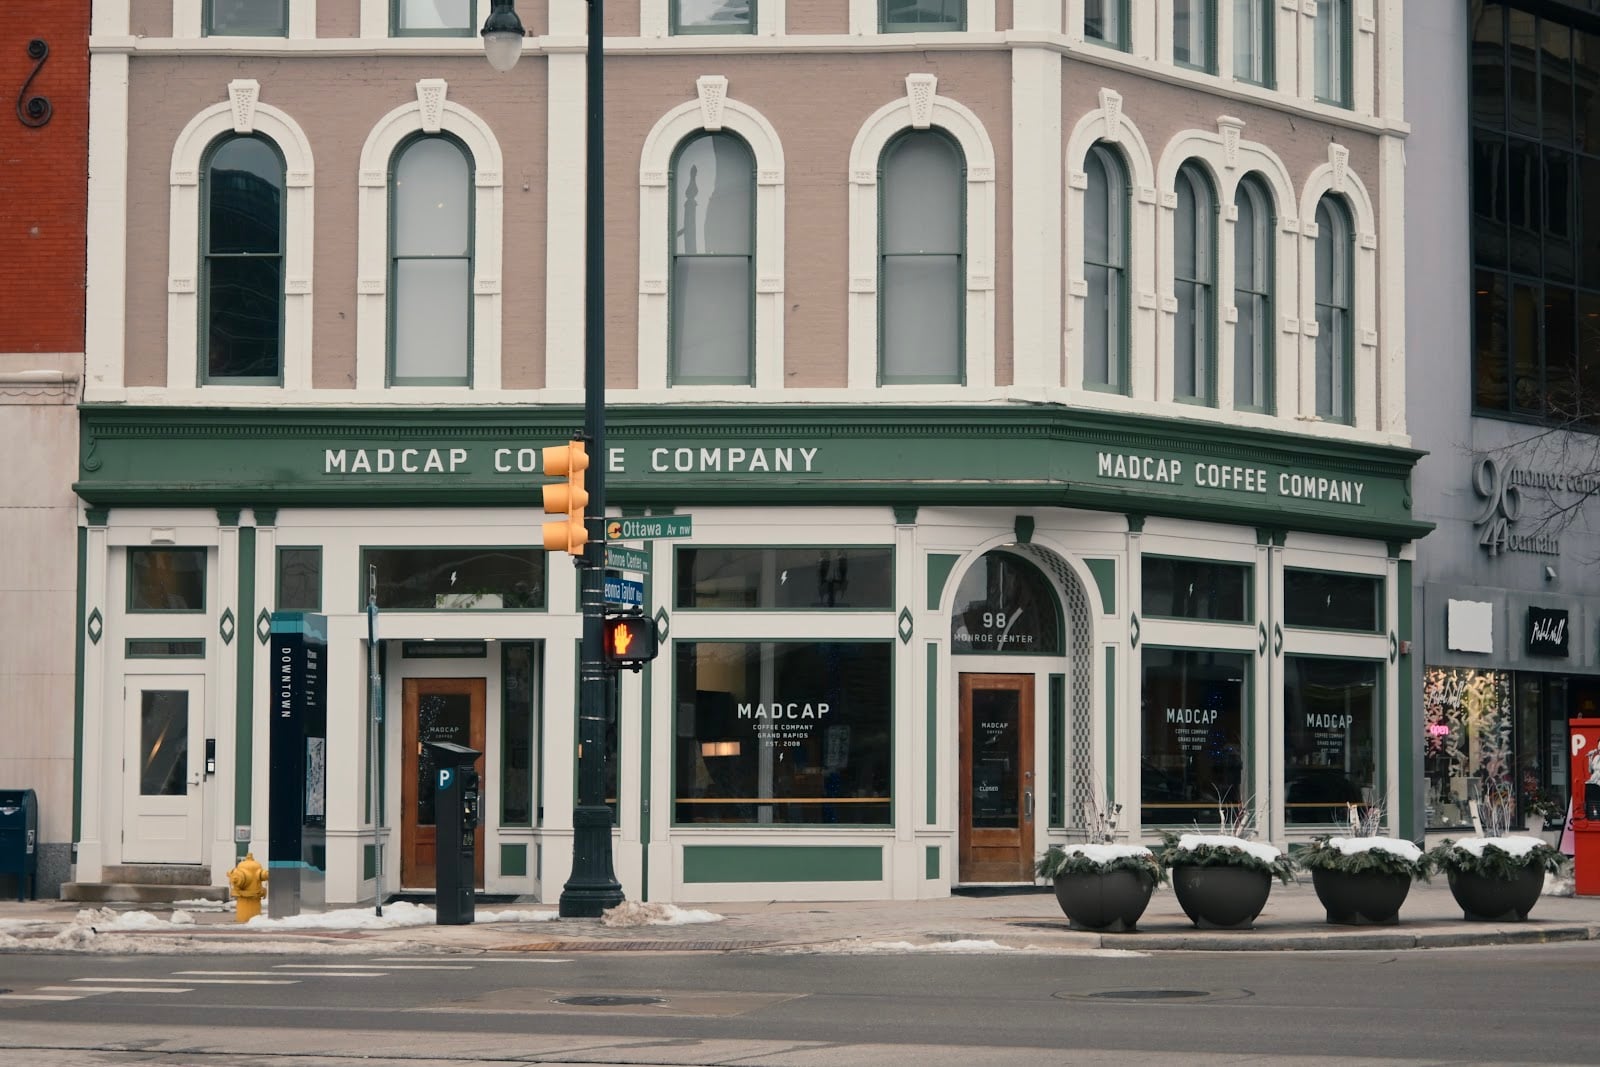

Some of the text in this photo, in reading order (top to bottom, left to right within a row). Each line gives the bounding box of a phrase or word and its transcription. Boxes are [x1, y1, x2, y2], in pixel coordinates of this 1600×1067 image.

[325, 447, 819, 473] MADCAP COE COMPANY
[1098, 452, 1364, 504] MADCAP COFFEE COMPANY
[1472, 456, 1521, 526] 96
[622, 521, 691, 538] Ottawa Av nw
[1507, 525, 1560, 556] ountain
[608, 549, 625, 567] Monroe
[626, 552, 642, 569] Center
[605, 583, 620, 598] eonna
[621, 583, 636, 603] Taylor
[982, 612, 1006, 628] 98
[953, 633, 1033, 643] MONROE CENTER
[281, 647, 291, 718] DOWNTOWN
[737, 703, 830, 719] MADCAP
[1166, 708, 1218, 724] MADCAP
[1306, 713, 1353, 728] MADCAP
[1571, 733, 1587, 756] P
[439, 769, 450, 786] P
